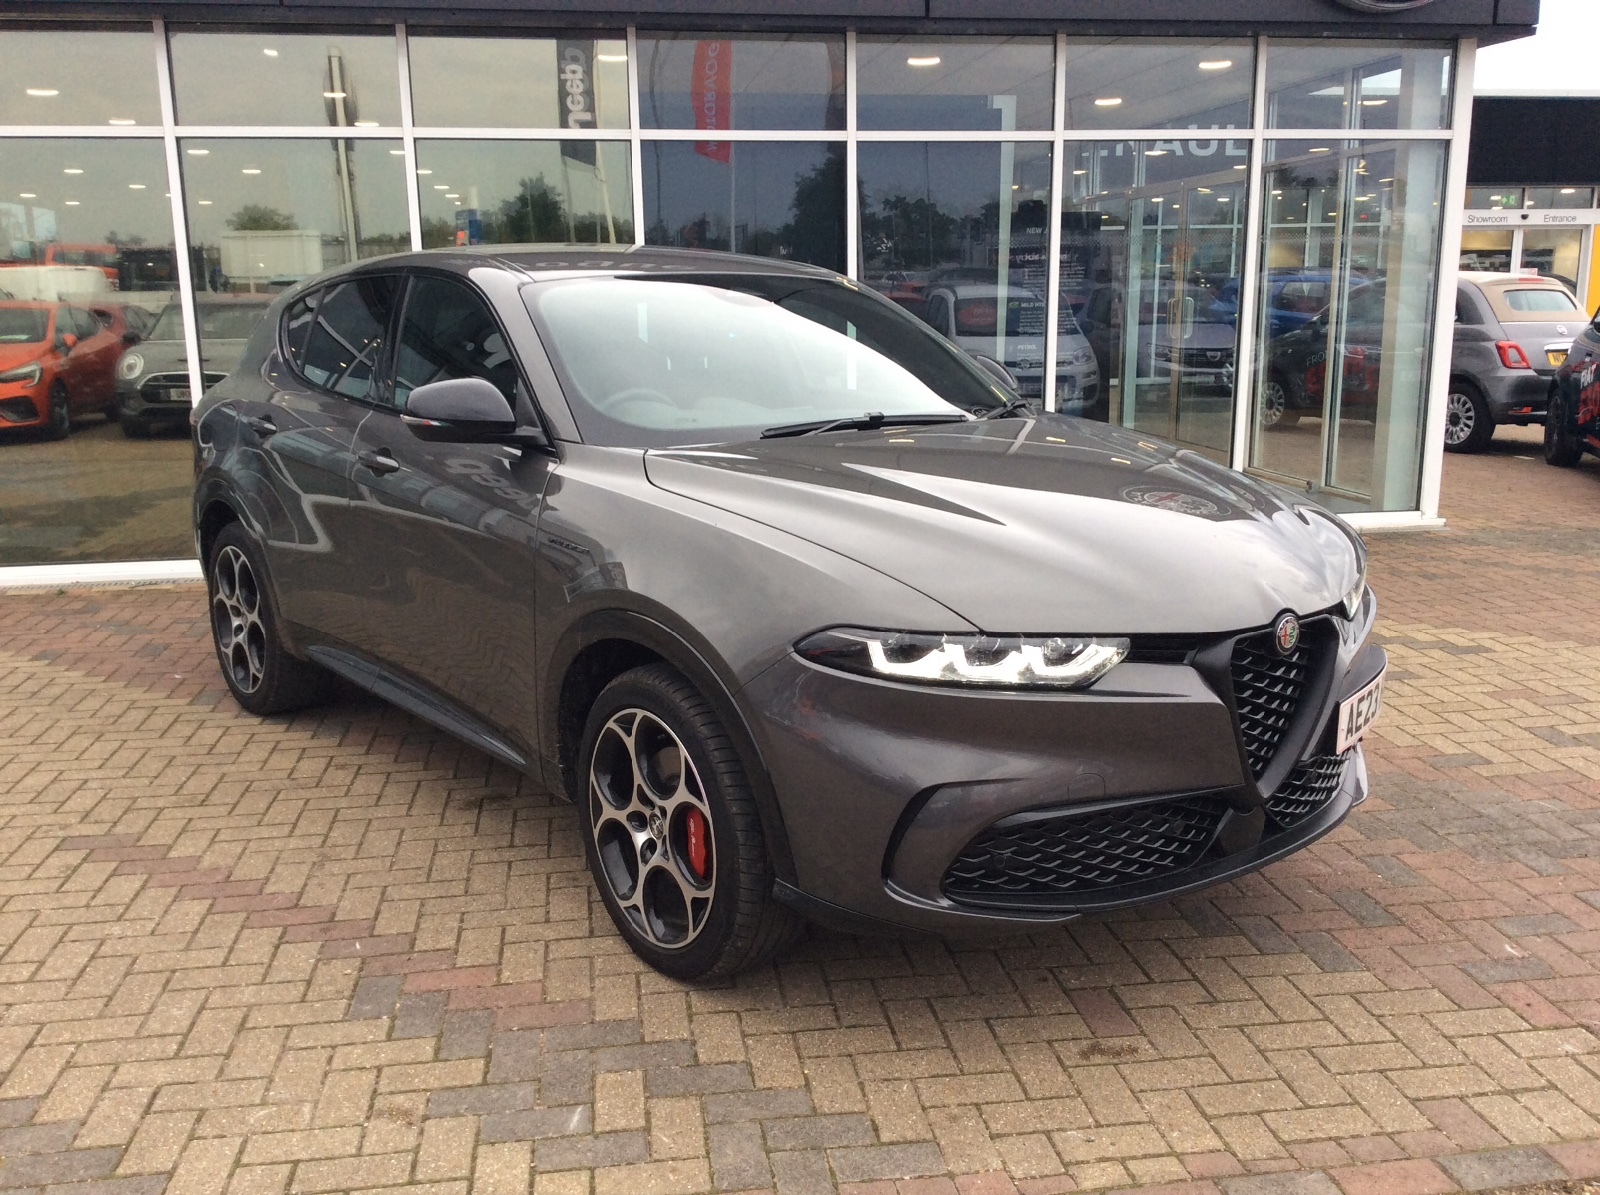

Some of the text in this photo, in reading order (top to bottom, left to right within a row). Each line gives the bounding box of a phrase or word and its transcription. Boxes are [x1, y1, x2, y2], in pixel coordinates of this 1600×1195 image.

[1467, 213, 1577, 224] Showroom Entrance
[1345, 682, 1380, 742] AE23
